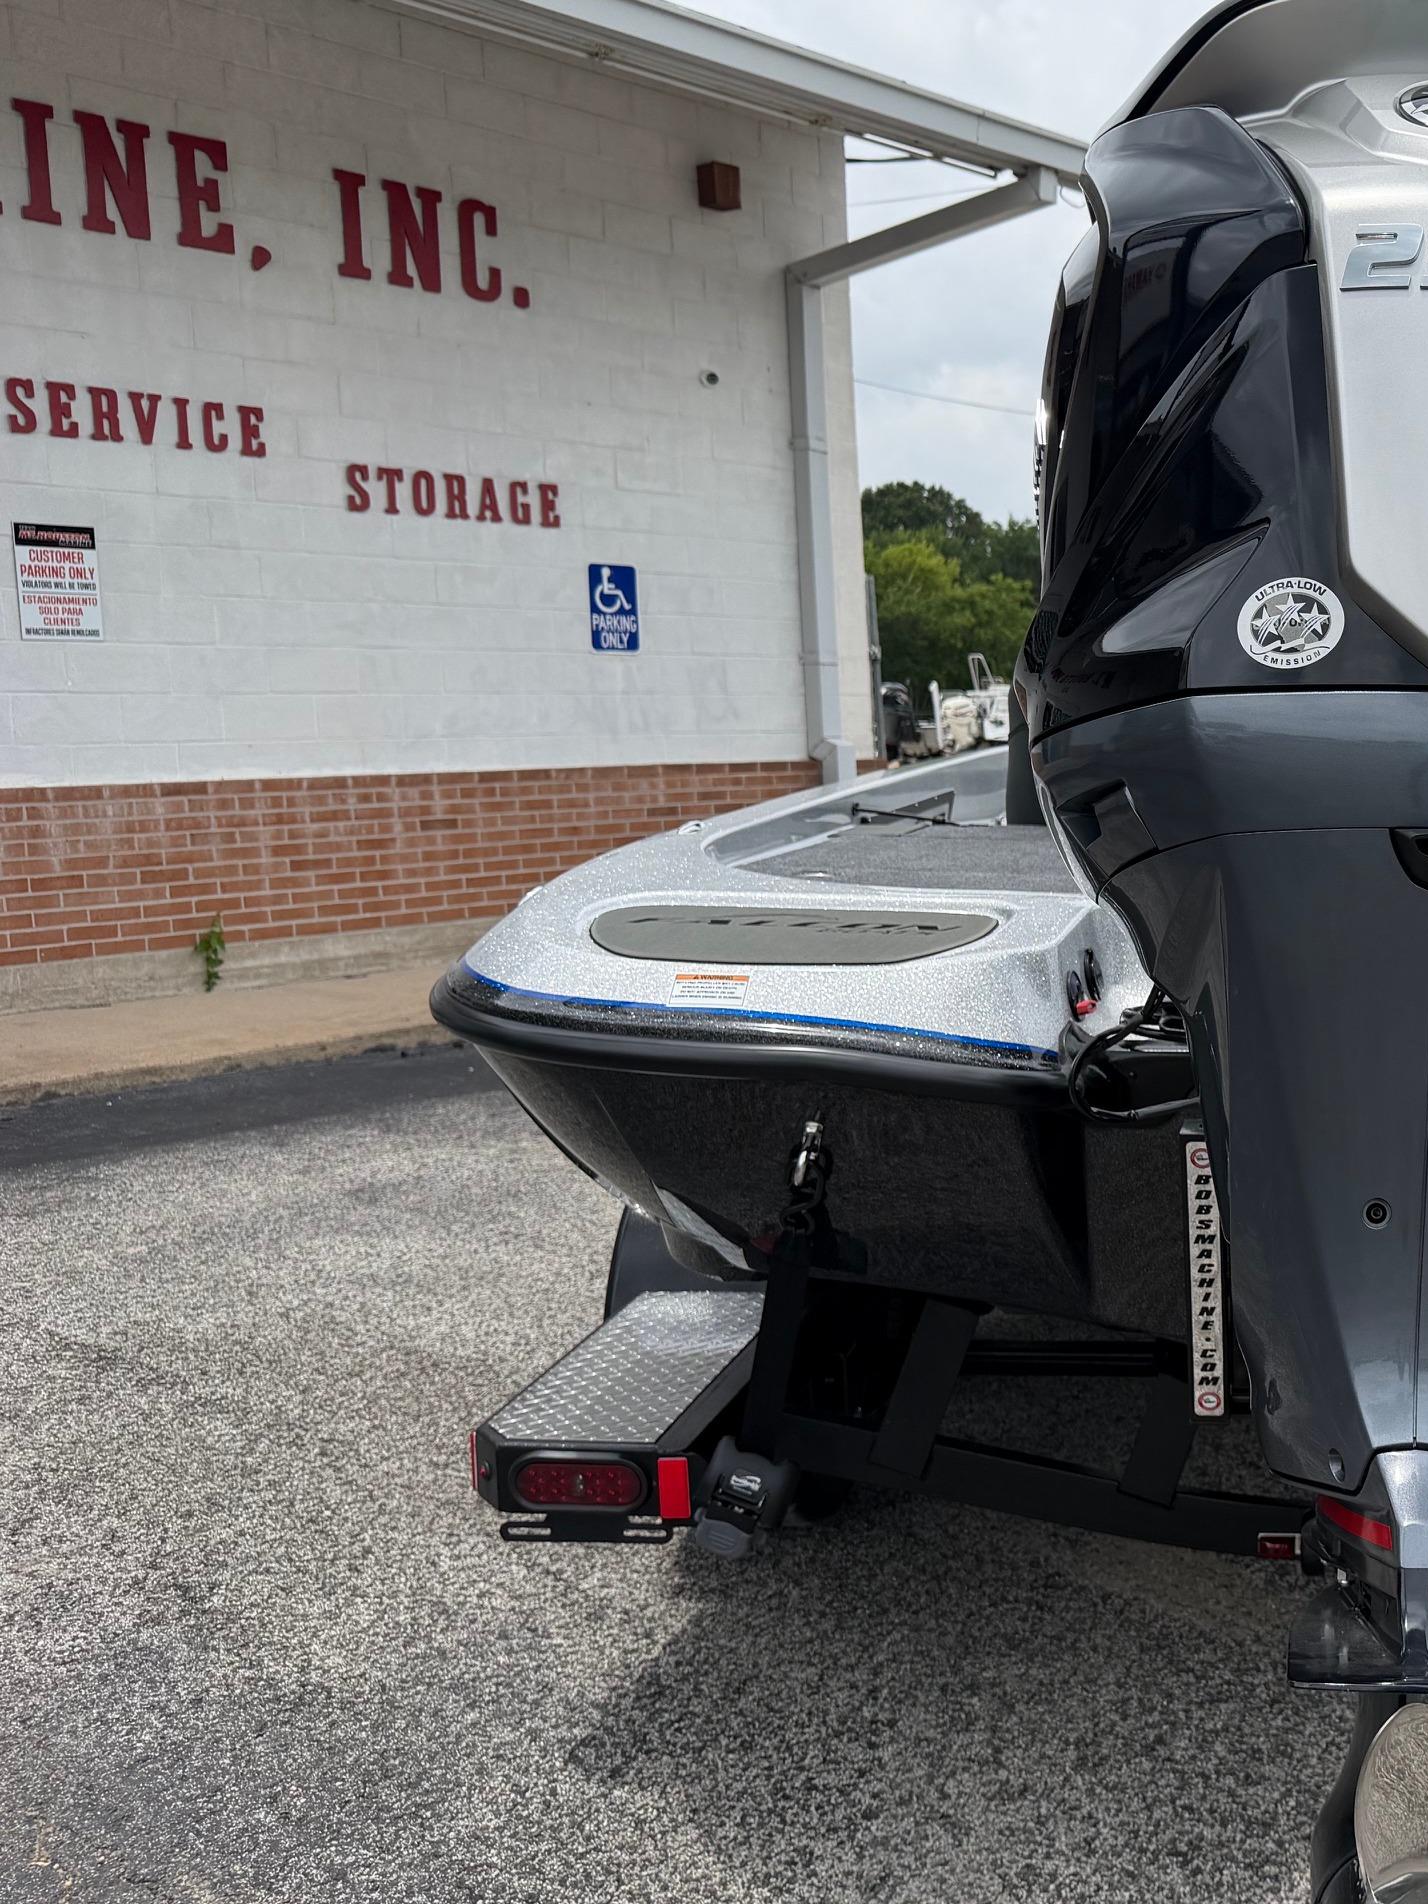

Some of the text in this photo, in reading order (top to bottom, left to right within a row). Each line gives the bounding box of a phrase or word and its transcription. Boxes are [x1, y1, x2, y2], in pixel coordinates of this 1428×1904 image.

[0, 97, 530, 309] INE, INC.
[5, 377, 267, 458] SERVICE
[345, 464, 561, 529] STORAGE
[29, 548, 85, 564] CUSTOMER
[20, 564, 95, 580] PARKING ONLY
[53, 581, 67, 590] WILL
[77, 582, 97, 591] TOWED
[22, 594, 98, 606] ESTACIONAMIENTO
[38, 606, 84, 616] SOLO PARA
[43, 617, 81, 627] CLIENTES
[592, 613, 637, 632] PARKING
[601, 632, 630, 648] ONLY
[1263, 650, 1321, 666] EMISSION
